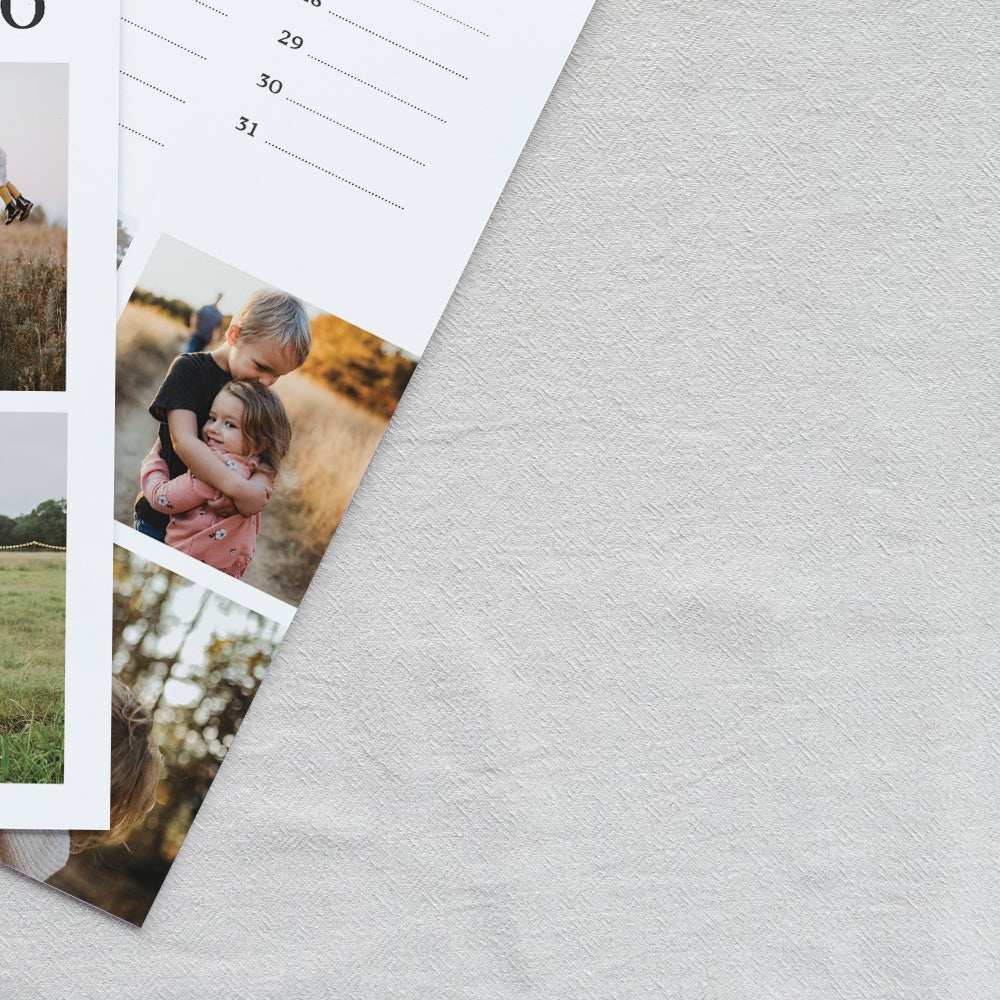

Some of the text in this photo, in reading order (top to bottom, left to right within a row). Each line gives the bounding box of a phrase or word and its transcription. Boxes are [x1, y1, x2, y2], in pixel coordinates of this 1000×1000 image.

[277, 29, 304, 50] 29
[256, 72, 283, 95] 30
[234, 116, 258, 138] 31
